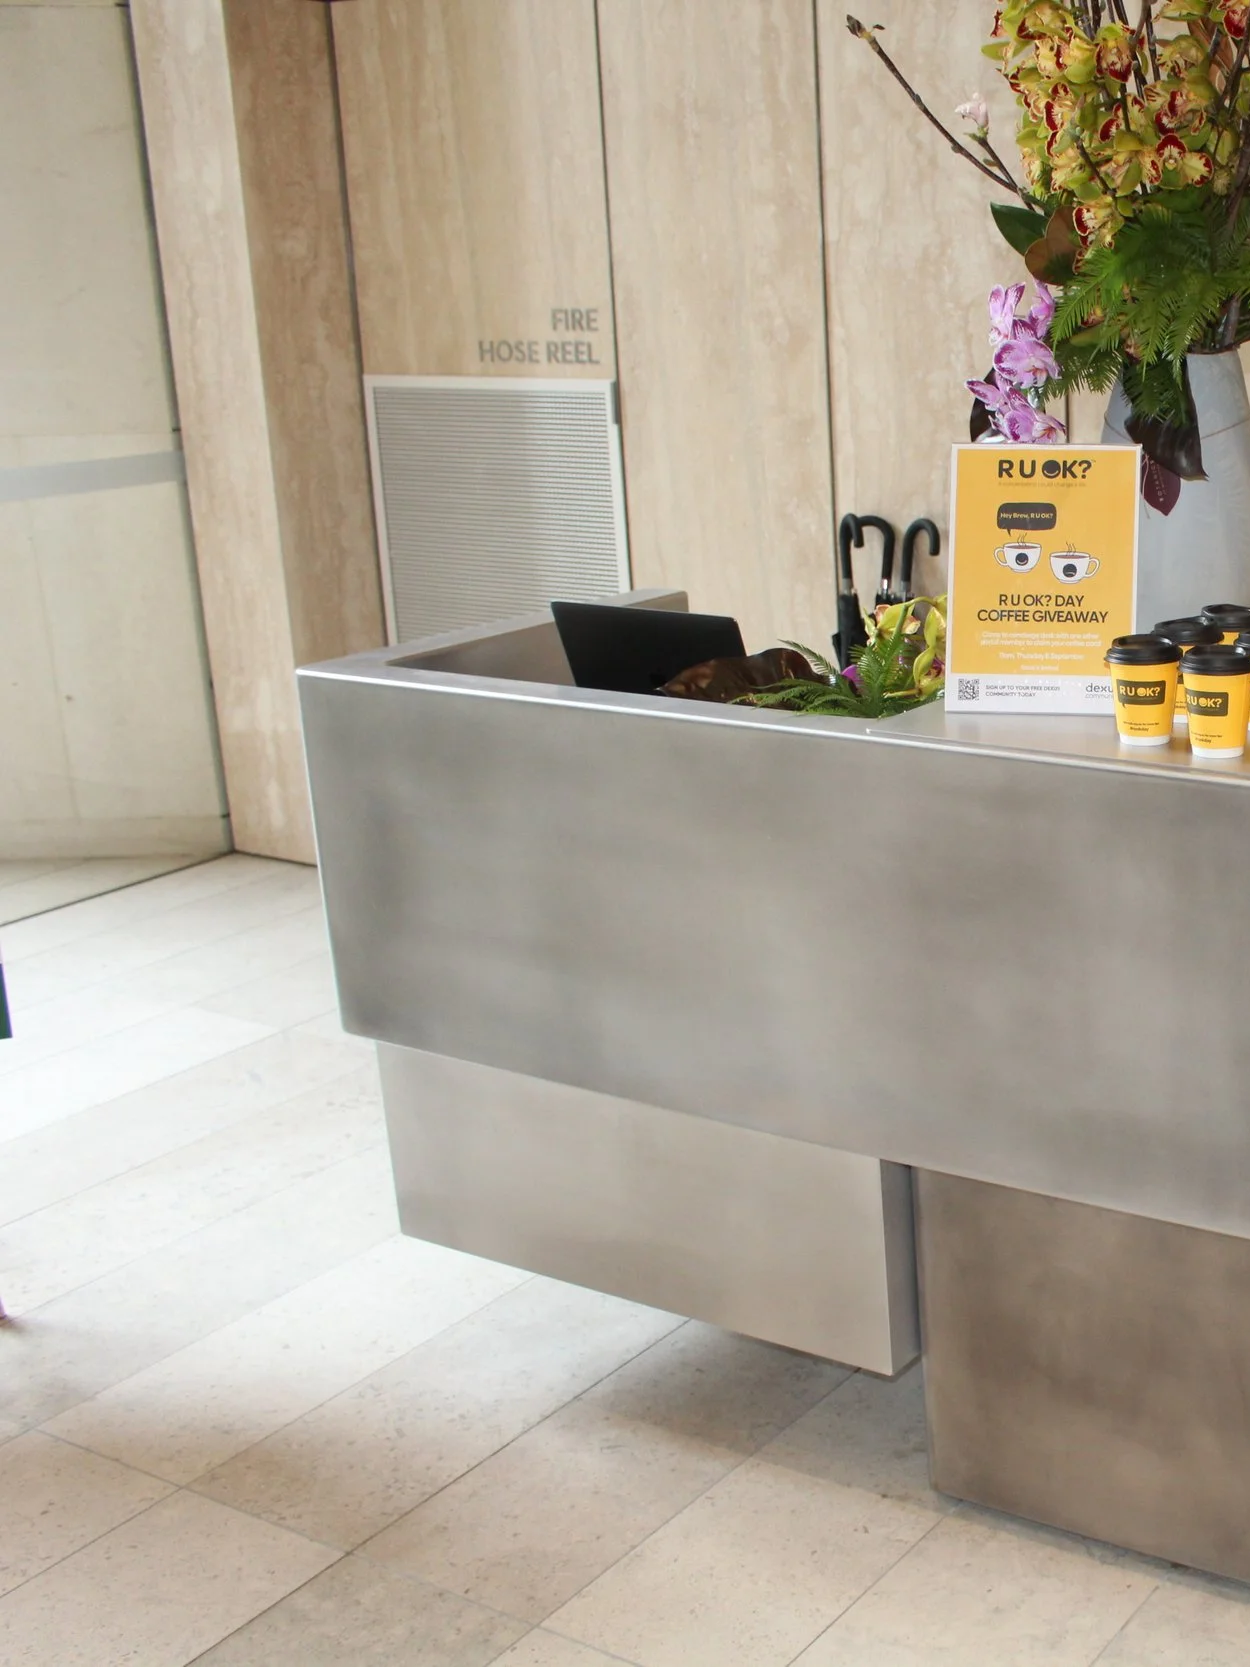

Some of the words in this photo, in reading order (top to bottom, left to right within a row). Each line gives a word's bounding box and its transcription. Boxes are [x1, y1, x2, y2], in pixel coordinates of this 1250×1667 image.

[551, 308, 599, 332] FIRE
[478, 340, 540, 363] HOSE
[546, 341, 601, 364] REEL
[998, 459, 1014, 478] R
[1019, 459, 1036, 478] U
[1042, 459, 1092, 479] OK?
[999, 594, 1008, 606] R
[1011, 594, 1020, 606] U
[1023, 594, 1051, 607] OK?
[1055, 595, 1085, 607] DAY
[977, 609, 1029, 622] COFFEE
[1032, 610, 1108, 623] GIVEAWAY
[1085, 683, 1113, 693] dexu
[1119, 685, 1126, 695] R
[1127, 686, 1135, 696] U
